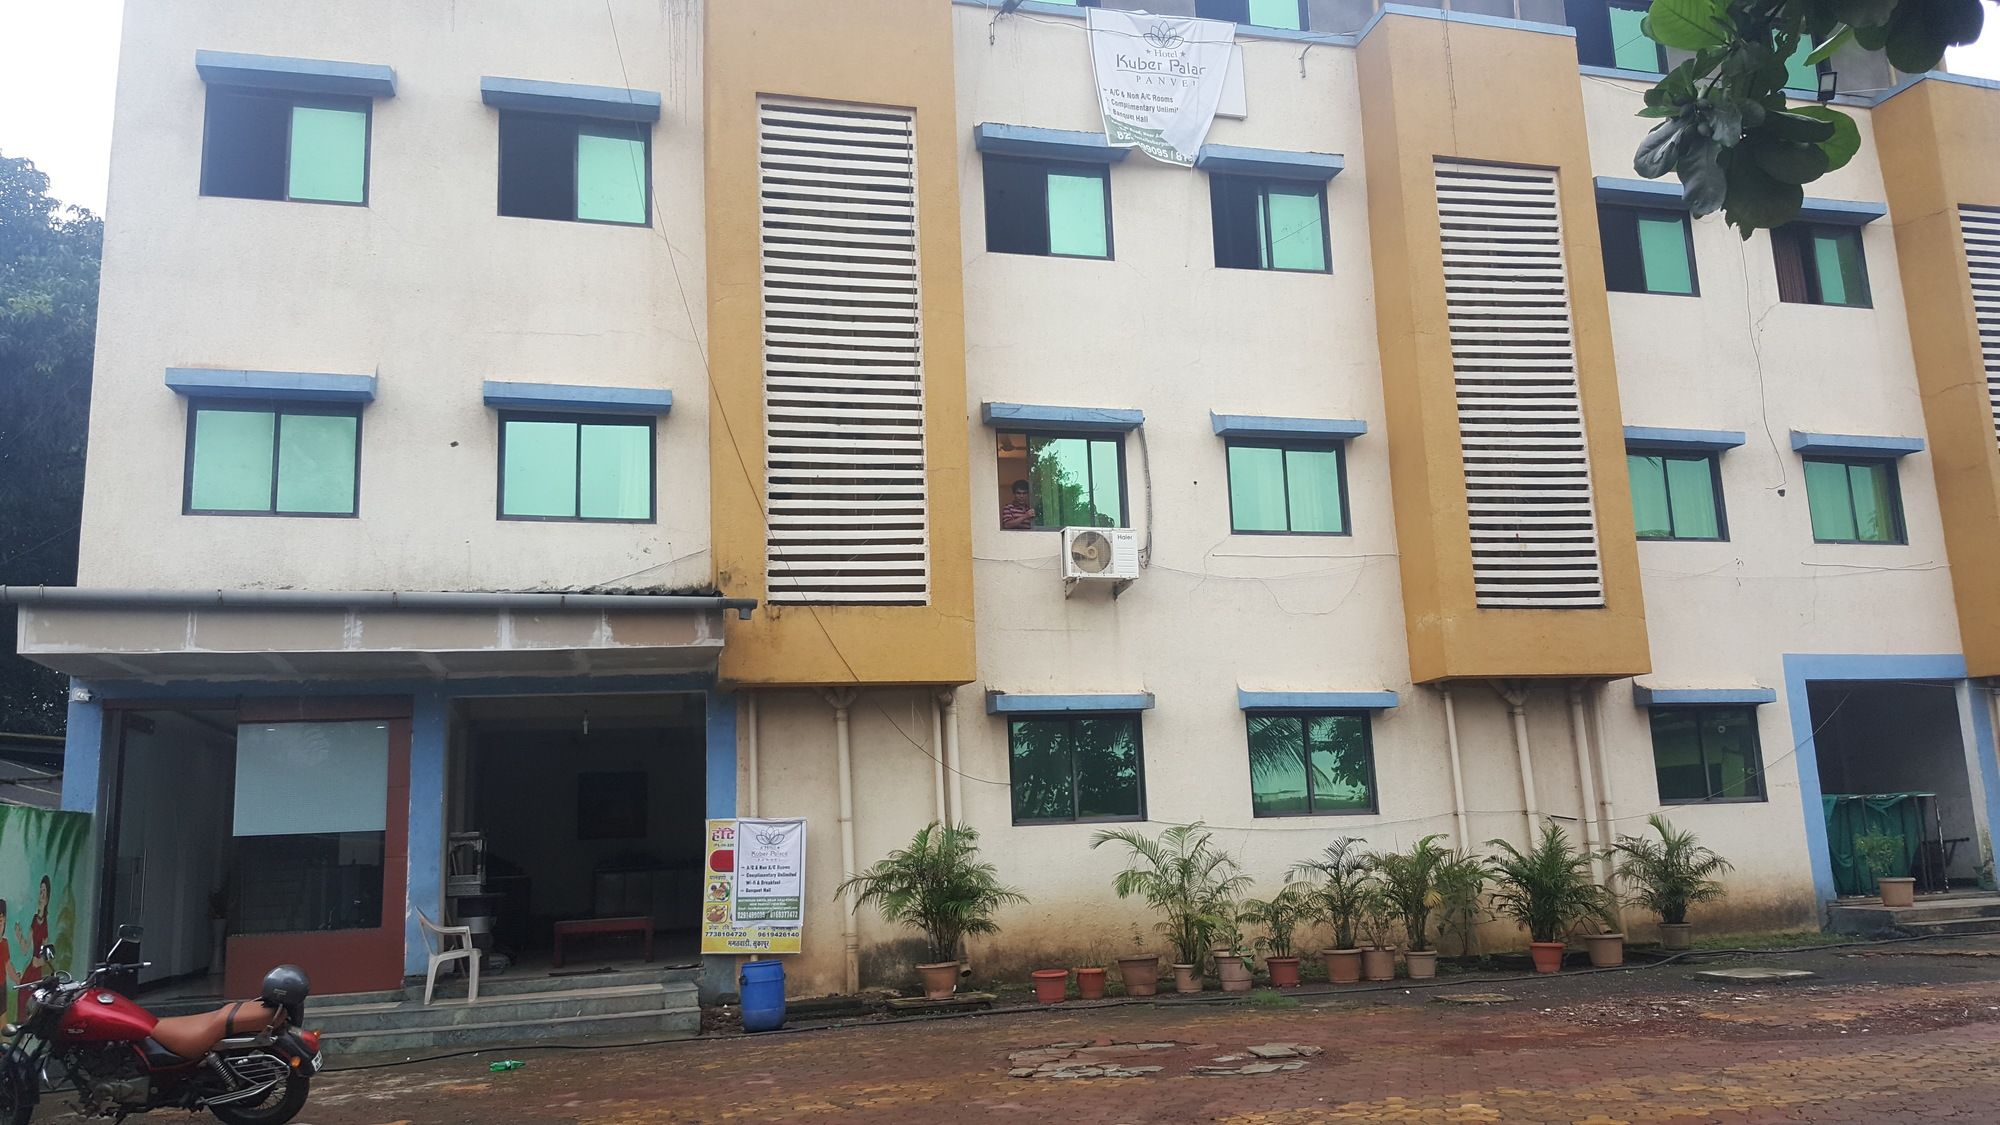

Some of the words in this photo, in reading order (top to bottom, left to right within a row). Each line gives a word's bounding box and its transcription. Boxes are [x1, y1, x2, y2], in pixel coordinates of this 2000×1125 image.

[1154, 49, 1178, 58] Hotel
[1116, 53, 1162, 71] Kuber
[1109, 88, 1120, 97] A/C
[1126, 91, 1140, 100] Non
[1152, 94, 1174, 103] Rooms
[1110, 98, 1155, 113] Complimentary
[1135, 115, 1149, 123] Hall
